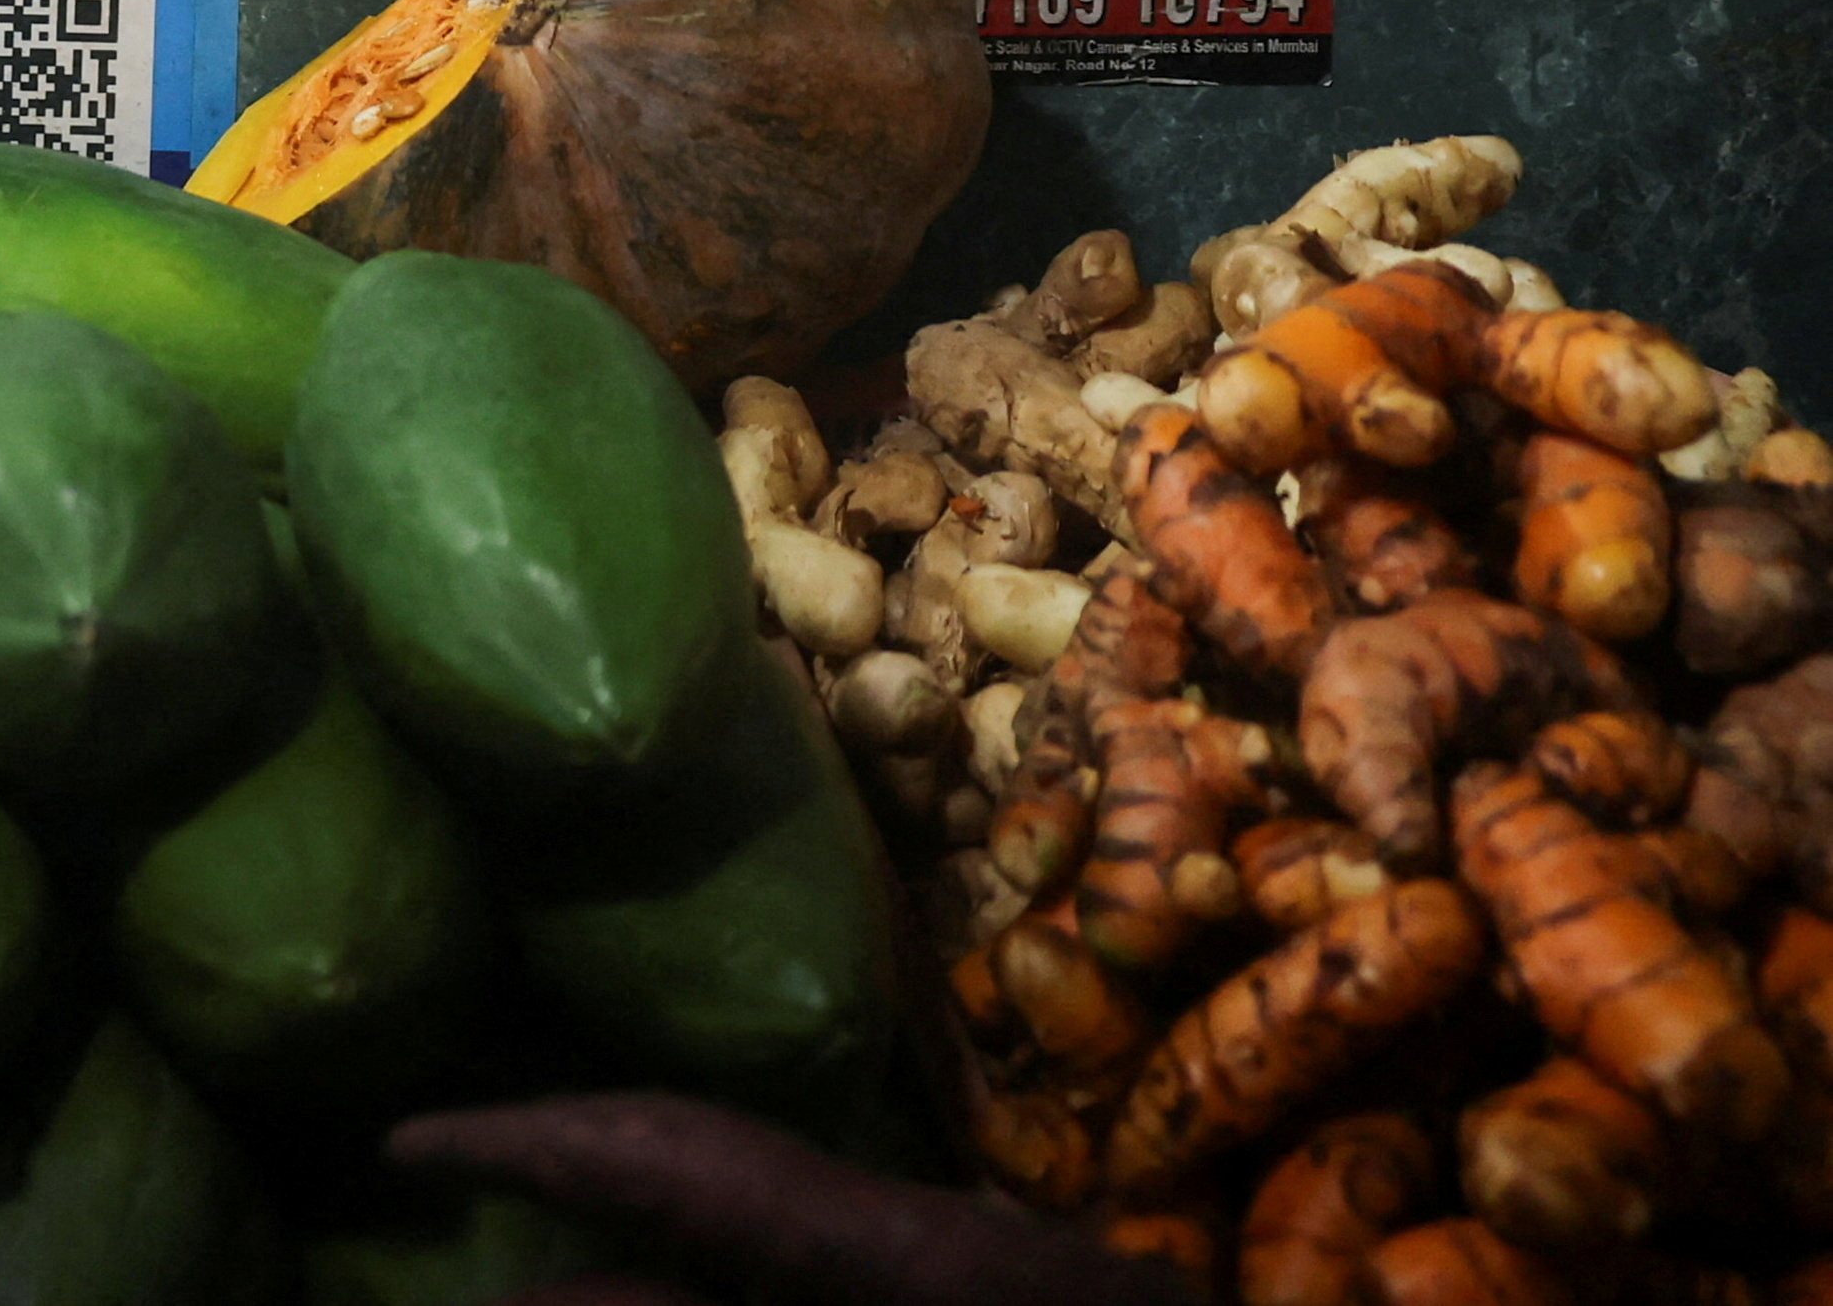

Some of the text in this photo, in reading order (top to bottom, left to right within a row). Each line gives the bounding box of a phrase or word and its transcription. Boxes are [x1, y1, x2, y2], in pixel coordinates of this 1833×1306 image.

[995, 41, 1030, 56] Scale
[1182, 39, 1192, 54] &
[1194, 39, 1249, 54] Services
[1251, 39, 1265, 53] in
[1267, 39, 1319, 54] Mumbai
[1065, 59, 1105, 71] Road
[1140, 59, 1157, 71] 12
